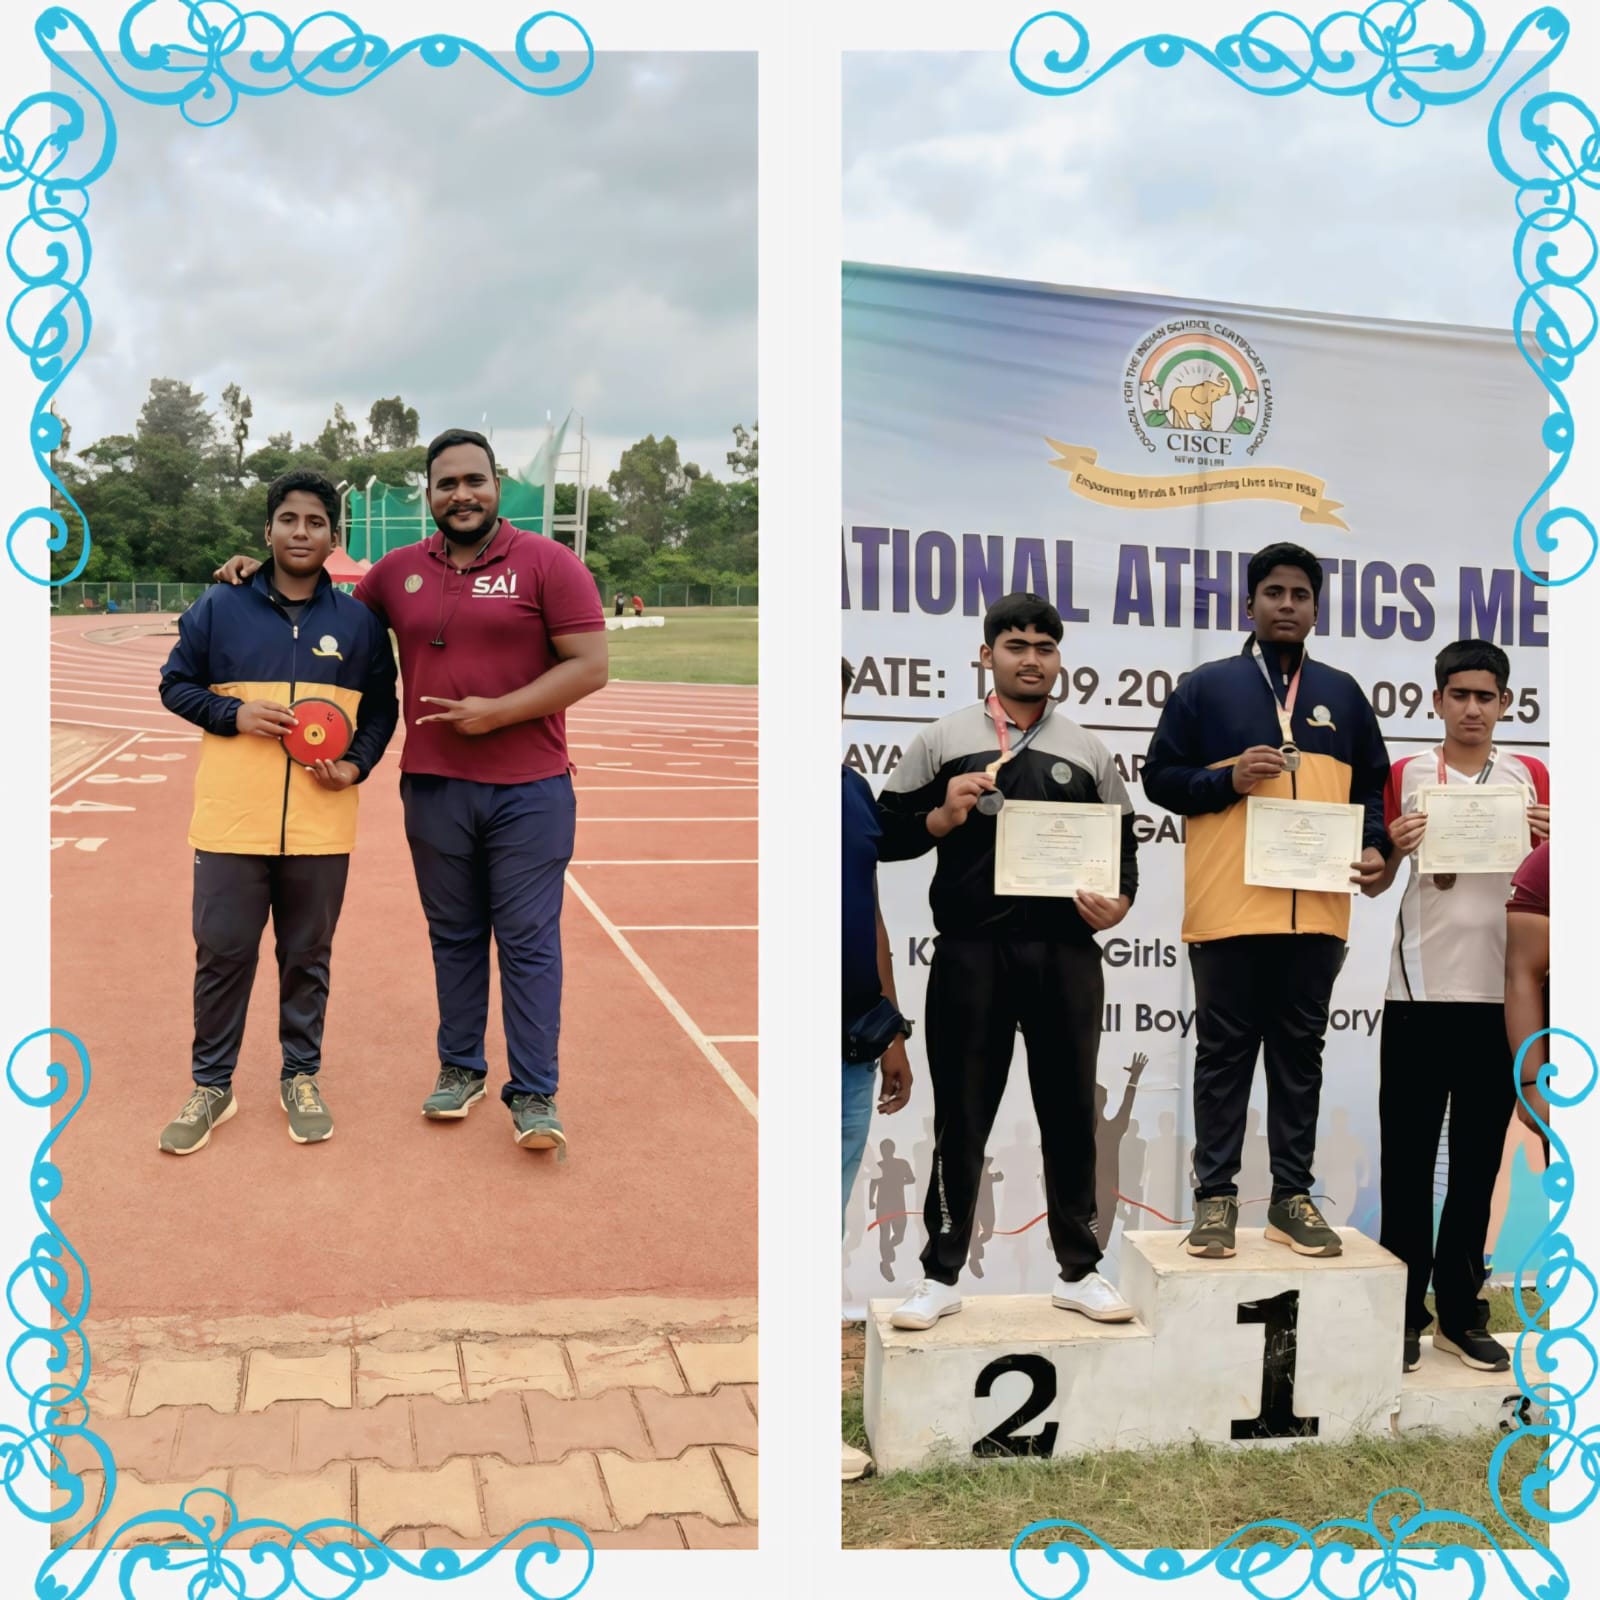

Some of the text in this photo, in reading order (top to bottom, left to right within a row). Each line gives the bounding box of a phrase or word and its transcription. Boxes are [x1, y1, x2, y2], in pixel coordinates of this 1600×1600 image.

[1126, 357, 1140, 380] THE
[1167, 433, 1232, 456] CISCE
[1169, 487, 1176, 496] &
[472, 573, 516, 594] SAI
[842, 524, 1090, 622] TIONAL
[1113, 544, 1435, 641] ATHTICS
[851, 655, 946, 698] ATE:
[1103, 938, 1177, 968] Girls
[1101, 1003, 1382, 1039] ll Boy ory
[1231, 1289, 1319, 1439] 1
[972, 1353, 1060, 1460] 2
